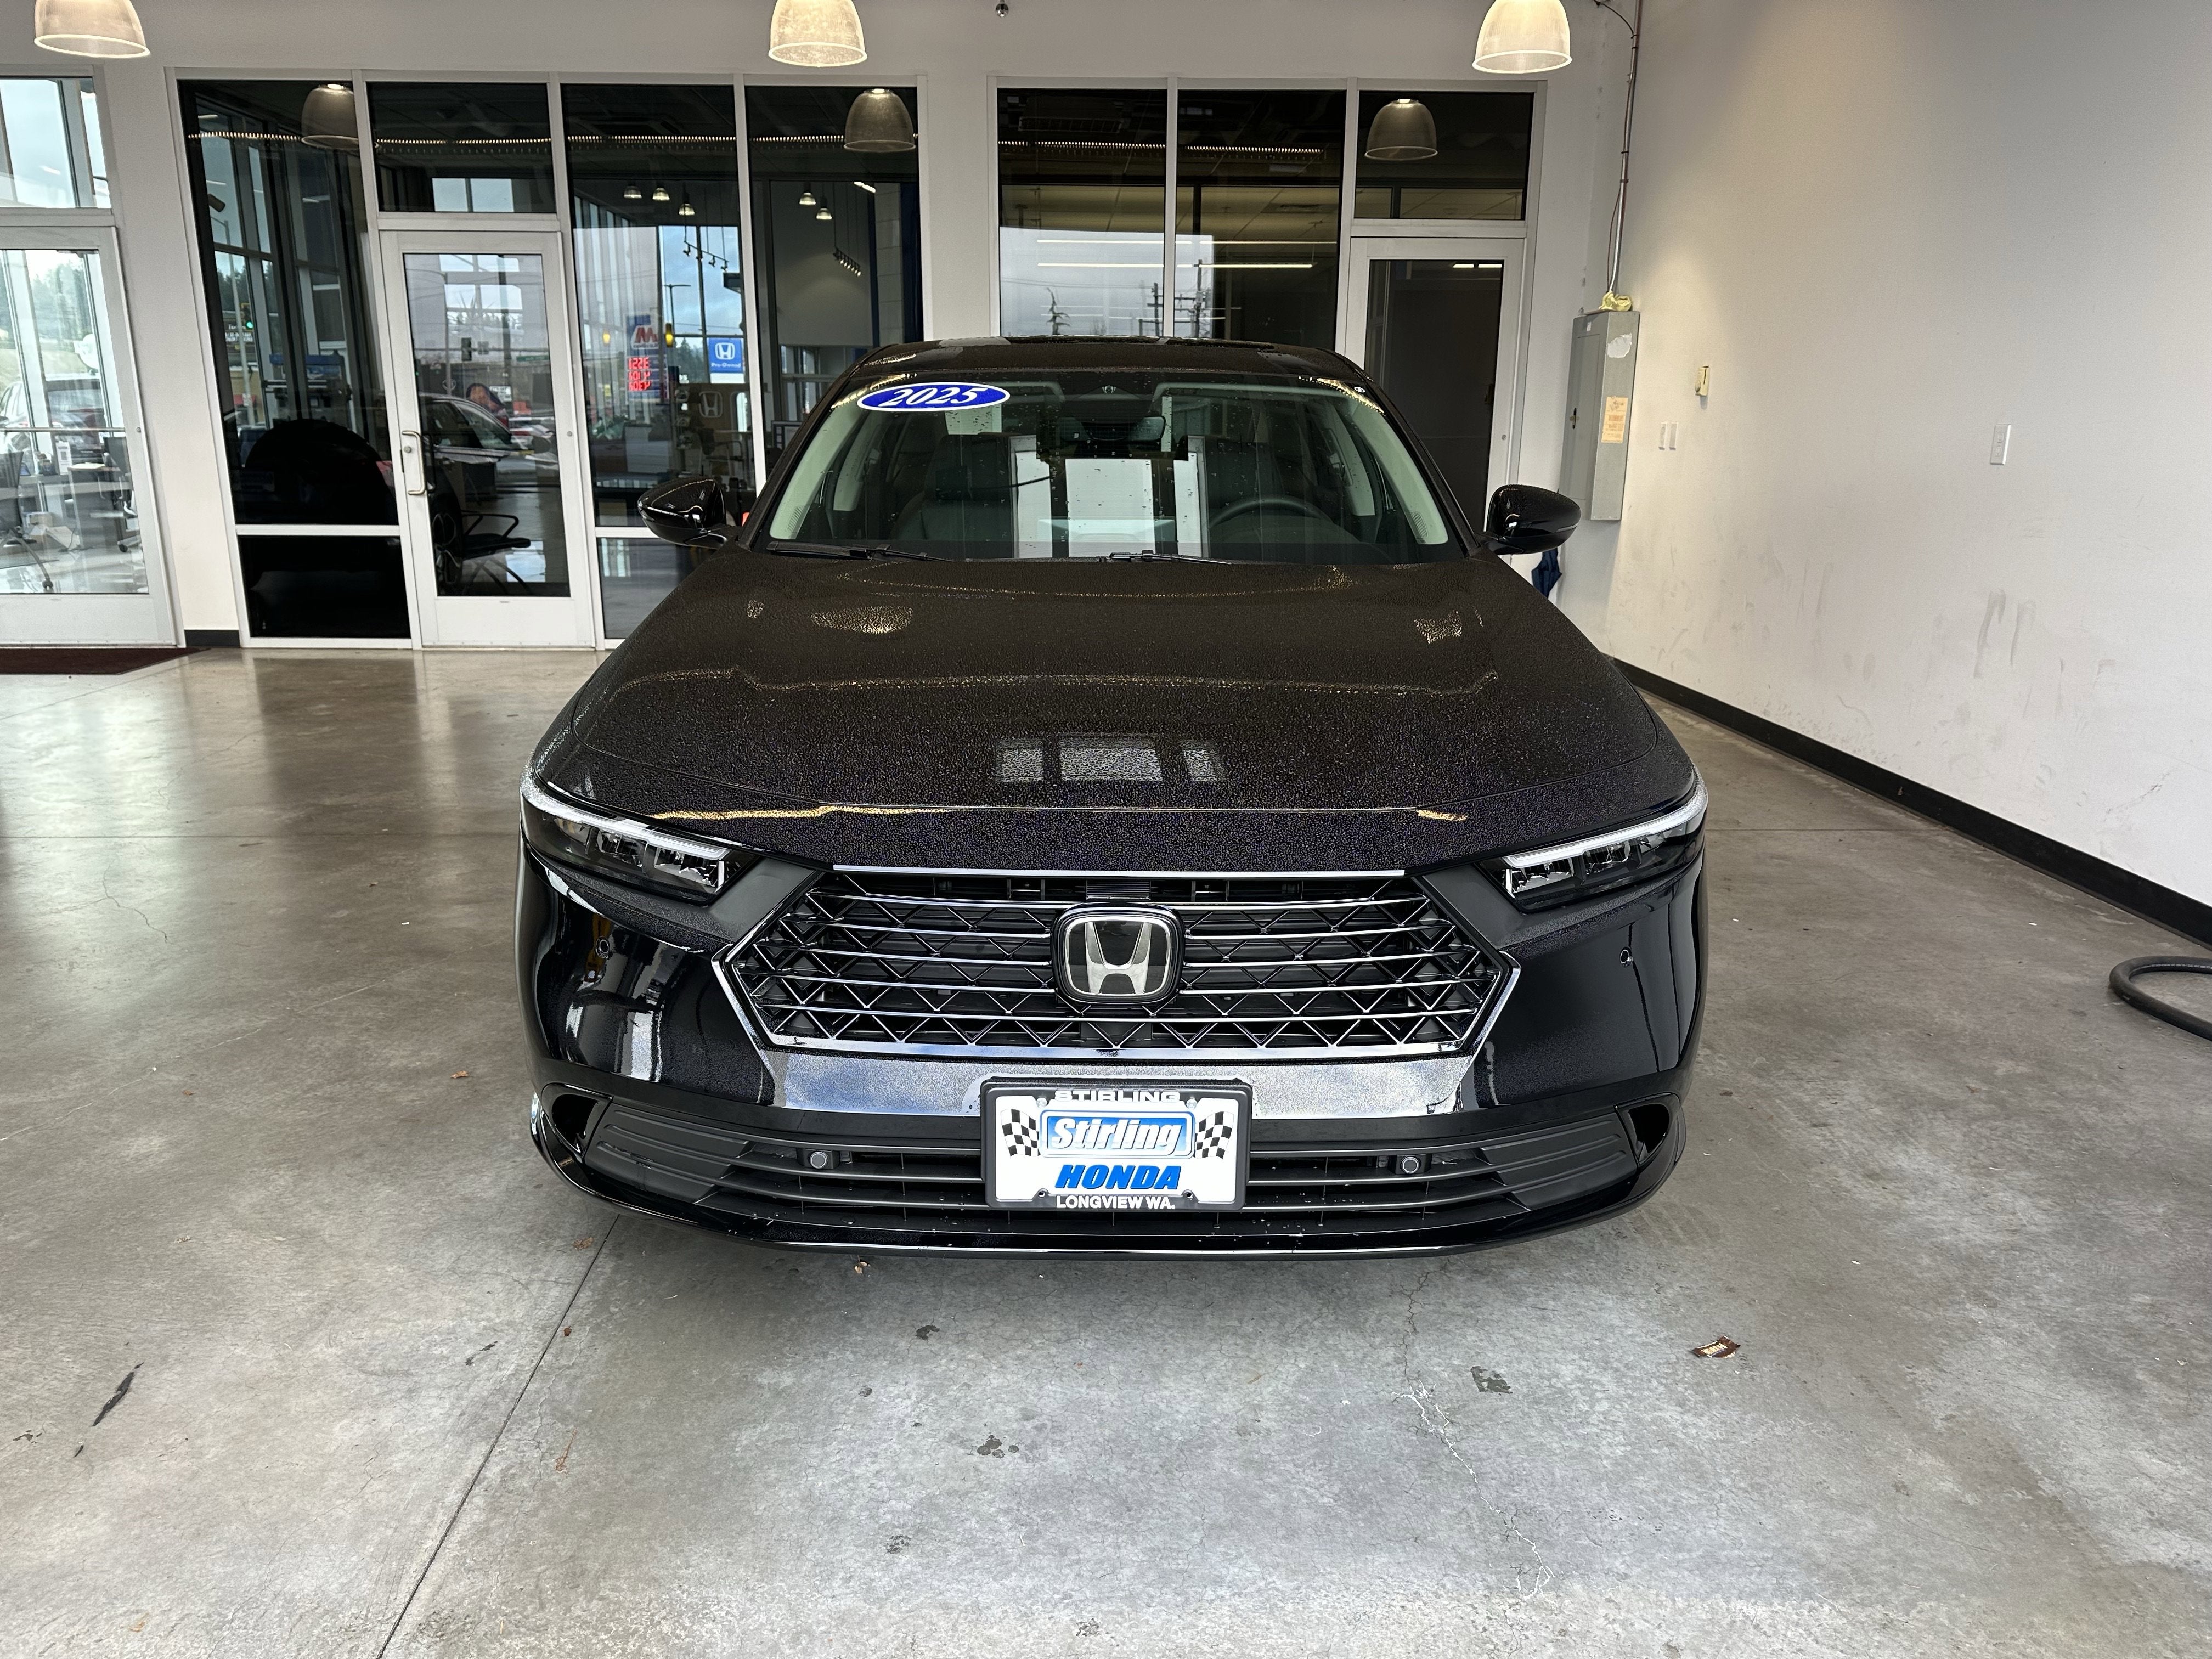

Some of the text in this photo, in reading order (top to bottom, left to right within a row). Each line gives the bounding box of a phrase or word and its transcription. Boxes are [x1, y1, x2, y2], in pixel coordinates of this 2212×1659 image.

[878, 387, 988, 407] 2025
[1054, 1090, 1180, 1103] STIRLING
[1051, 1118, 1183, 1156] Stirling
[1054, 1164, 1182, 1190] HONDA
[1056, 1195, 1176, 1210] LONGVIEW WA.
